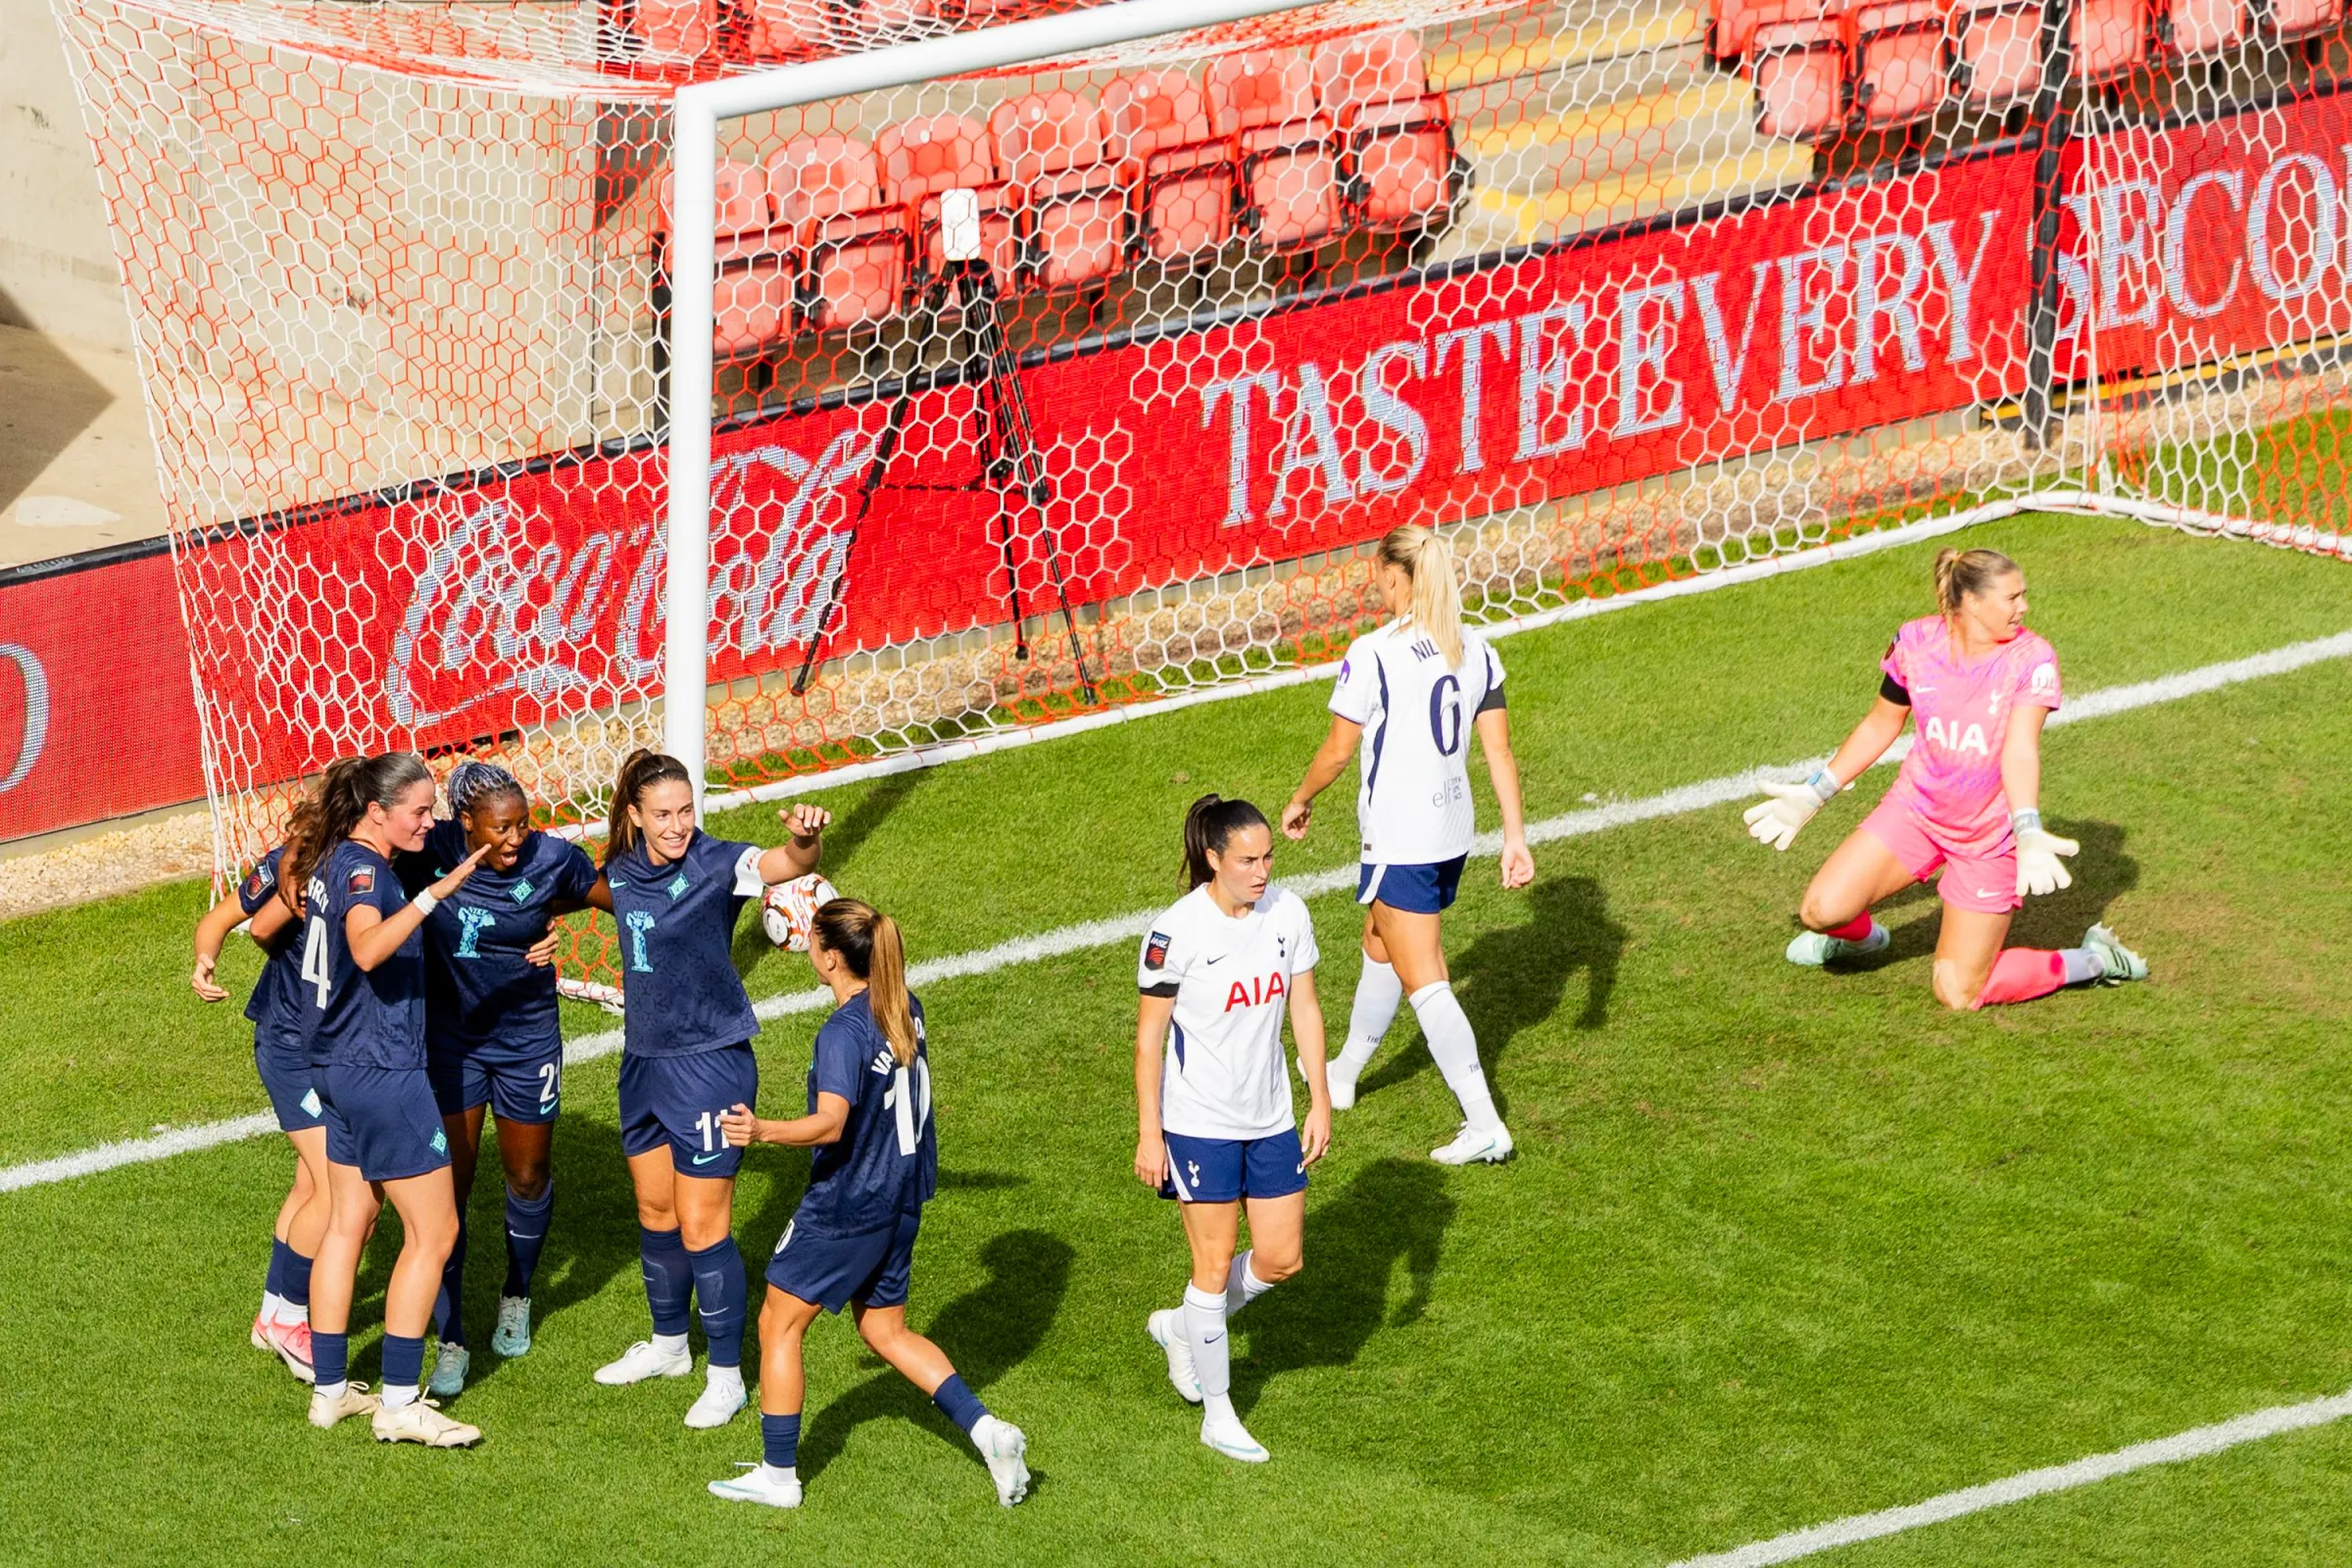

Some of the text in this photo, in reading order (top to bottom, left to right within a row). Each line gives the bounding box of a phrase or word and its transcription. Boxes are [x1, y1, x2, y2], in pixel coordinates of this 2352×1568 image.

[1201, 143, 2352, 528] TASTE EVERY SECO
[1410, 638, 1440, 663] NIL
[1429, 674, 1461, 758] 6
[1926, 716, 1988, 756] AIA
[302, 914, 331, 1010] 4
[1224, 971, 1285, 1013] AIA
[884, 1054, 931, 1157] 10
